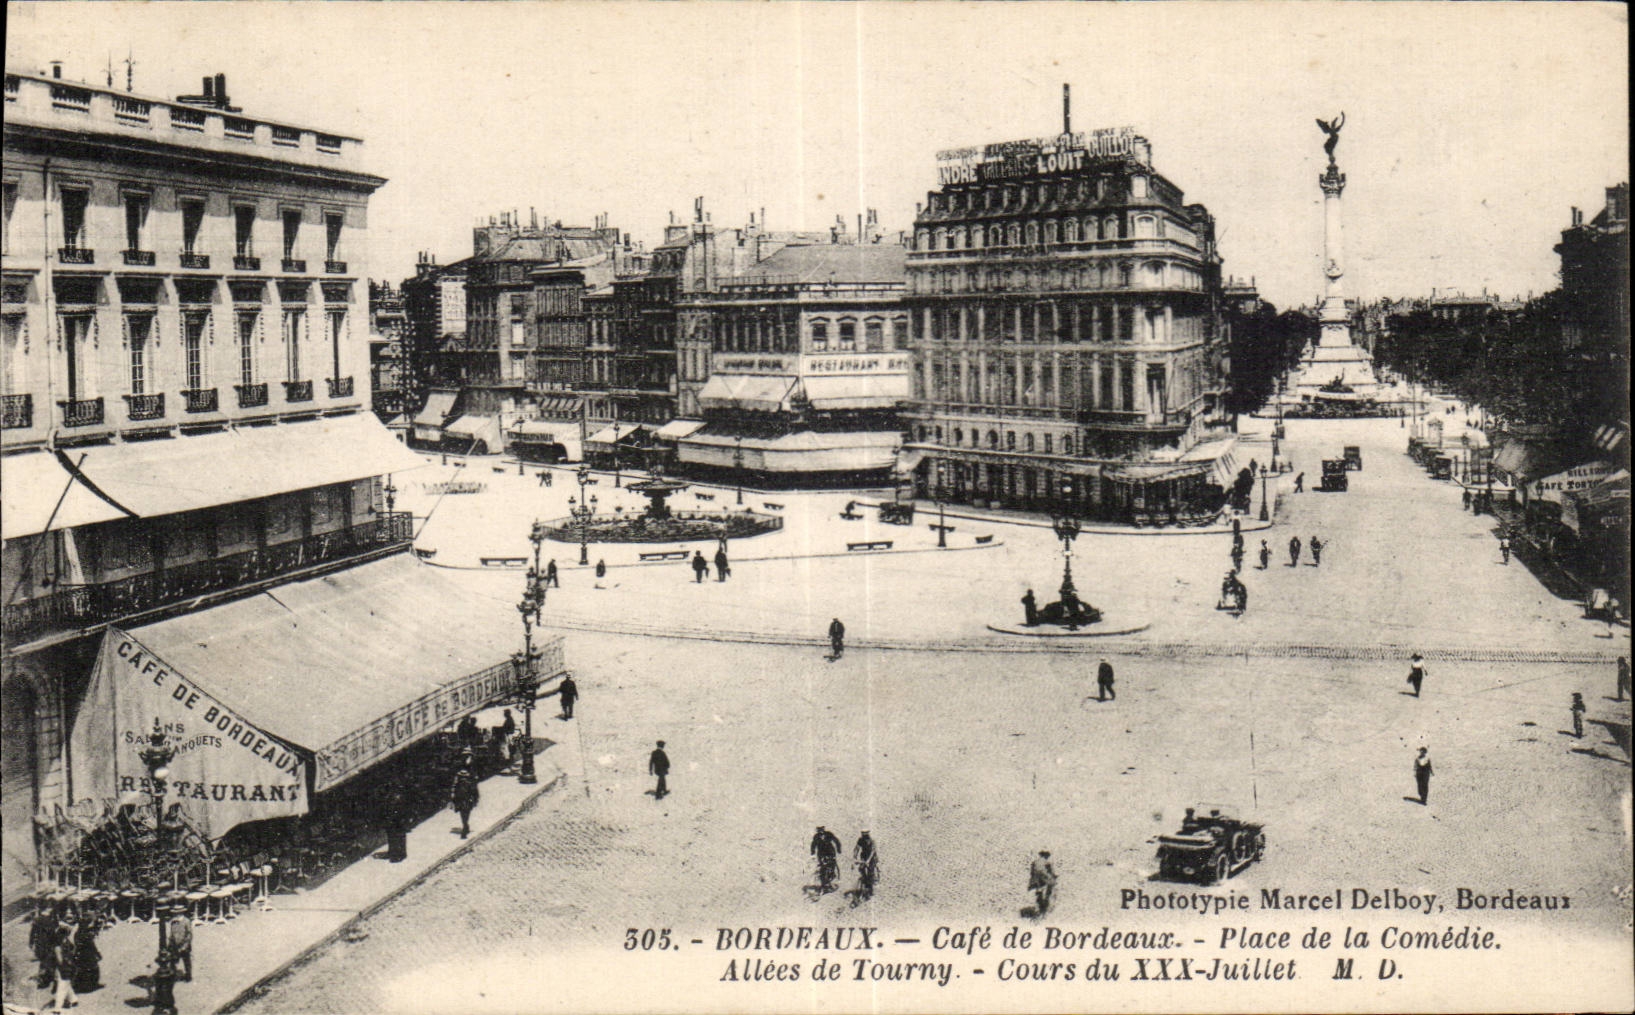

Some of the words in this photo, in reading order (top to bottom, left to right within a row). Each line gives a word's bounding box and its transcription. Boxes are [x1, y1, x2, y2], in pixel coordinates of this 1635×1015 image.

[1037, 151, 1085, 174] LOUIT
[118, 641, 169, 687] CAFE
[172, 683, 200, 710] DE
[204, 706, 302, 777] BORDEAUX
[125, 722, 185, 745] SALNS
